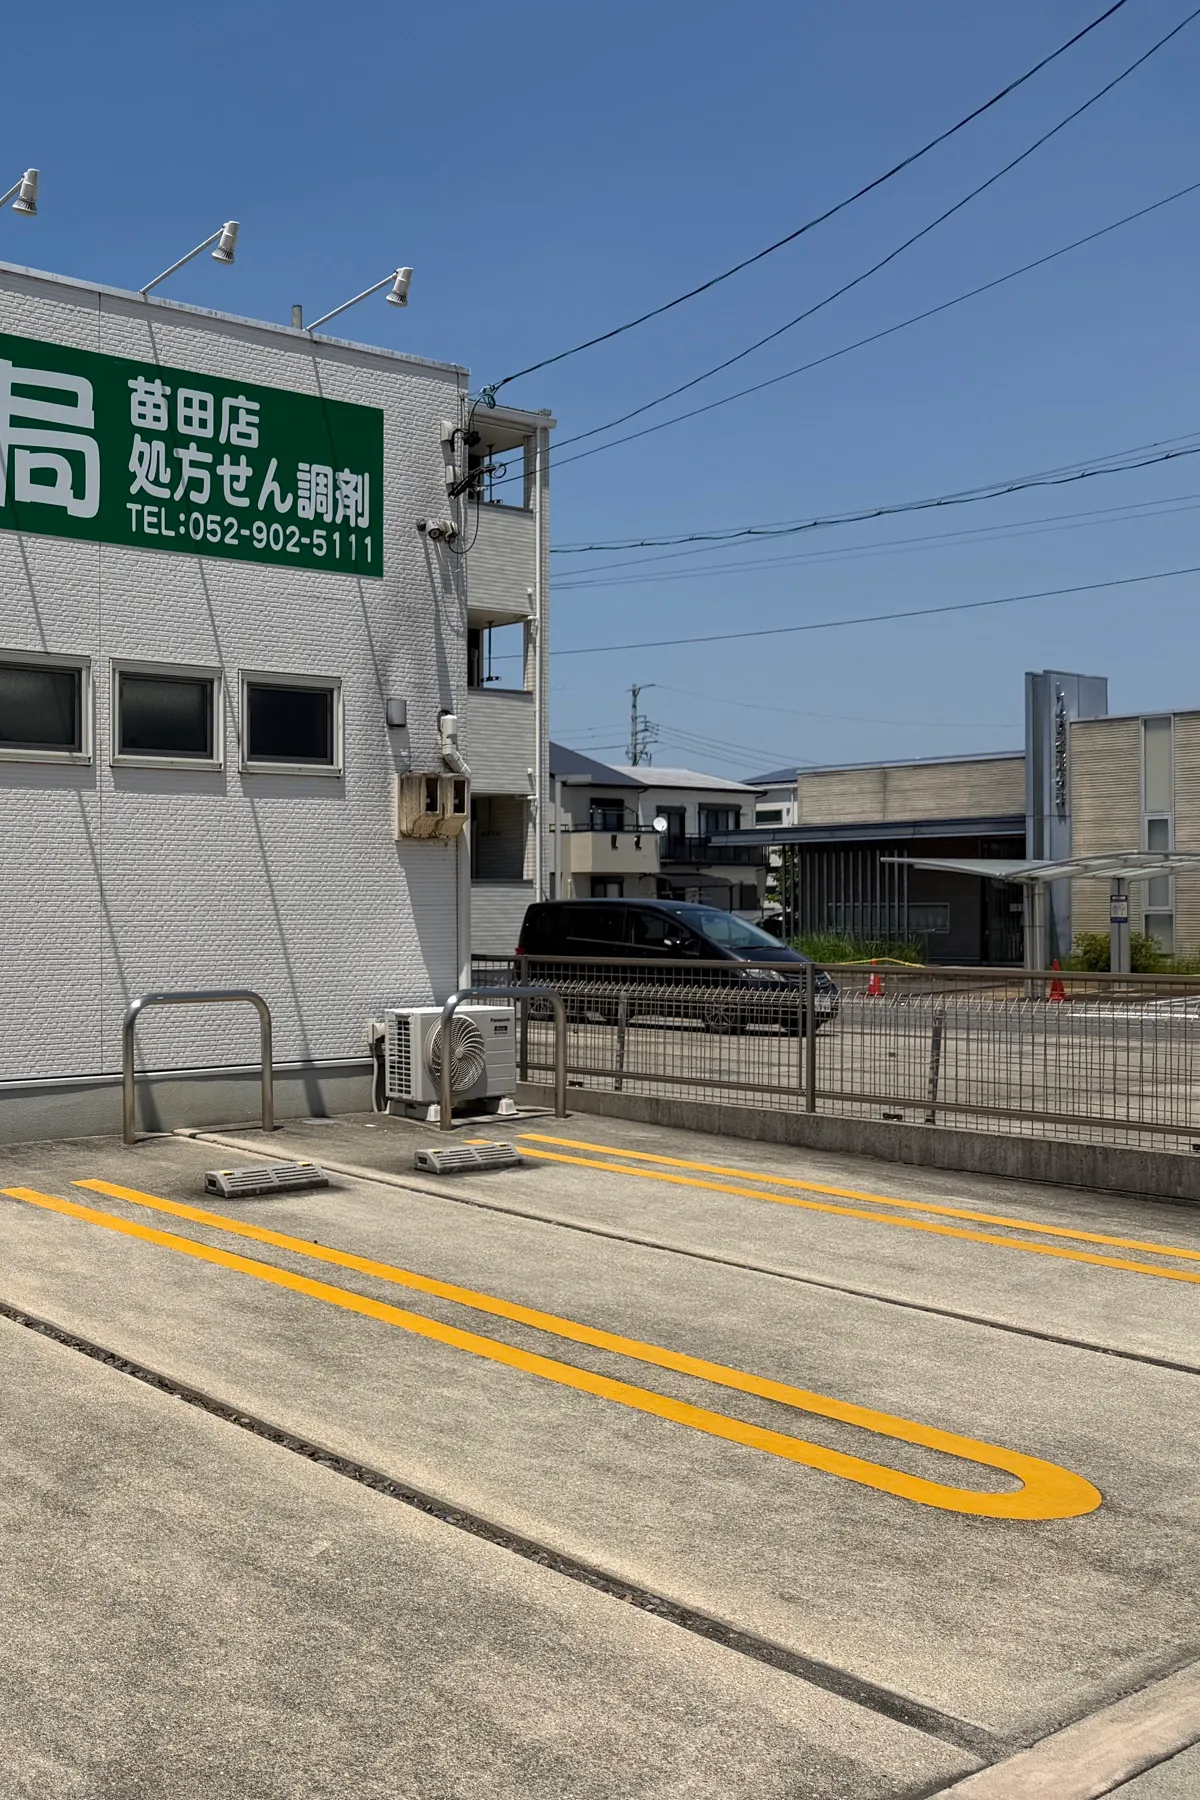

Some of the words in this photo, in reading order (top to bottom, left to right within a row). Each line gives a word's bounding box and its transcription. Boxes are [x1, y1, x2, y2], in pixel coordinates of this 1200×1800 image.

[127, 375, 261, 449] 苗田店
[128, 433, 370, 529] 処方せん調剤
[126, 502, 372, 563] TEL:052-902-5111
